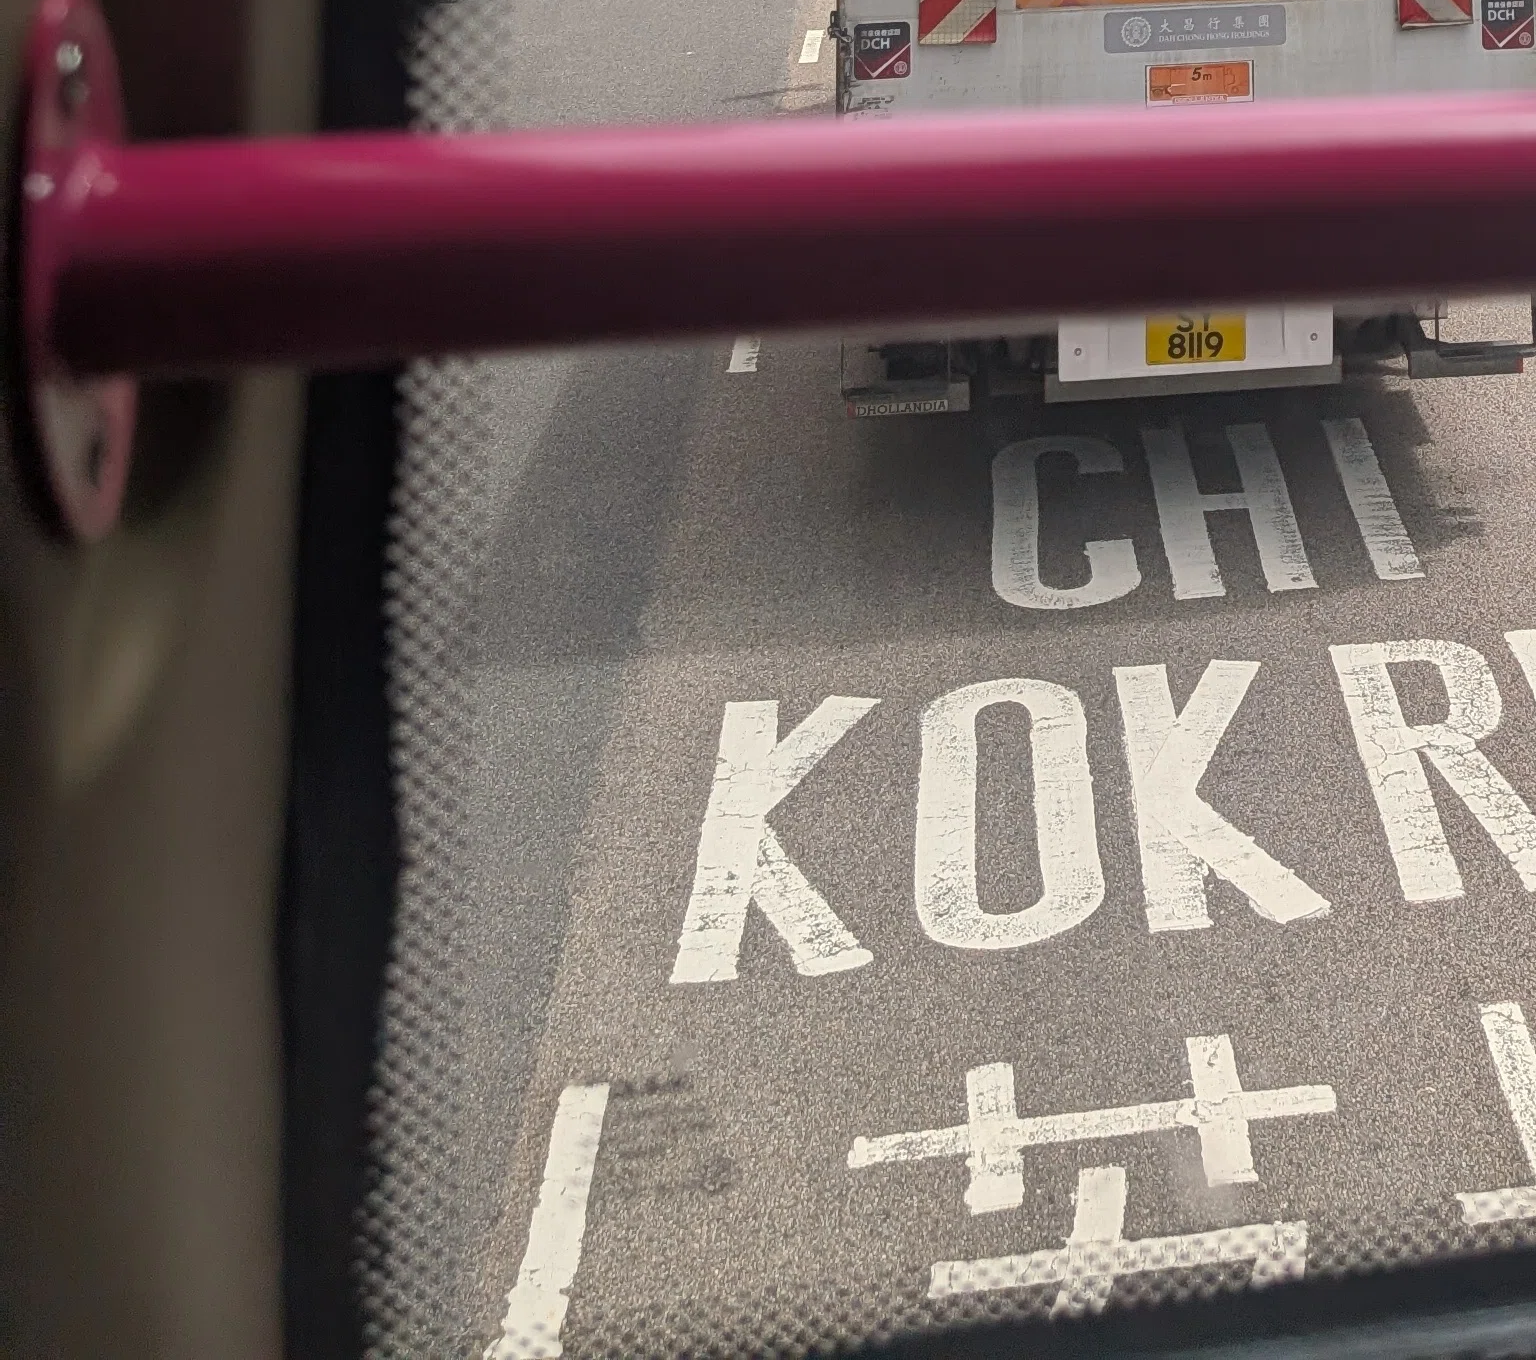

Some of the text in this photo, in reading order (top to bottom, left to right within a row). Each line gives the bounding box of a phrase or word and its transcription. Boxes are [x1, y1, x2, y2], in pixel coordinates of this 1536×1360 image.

[1160, 14, 1270, 33] 大昌行集團
[1488, 9, 1515, 21] DCH
[861, 38, 891, 50] DCH
[1158, 30, 1270, 43] DAH CHONG HONG HOLDINGS
[1168, 331, 1224, 359] 8119
[856, 400, 947, 416] DHOLLANDIA
[991, 417, 1426, 610] CHI
[668, 659, 1331, 985] KOK
